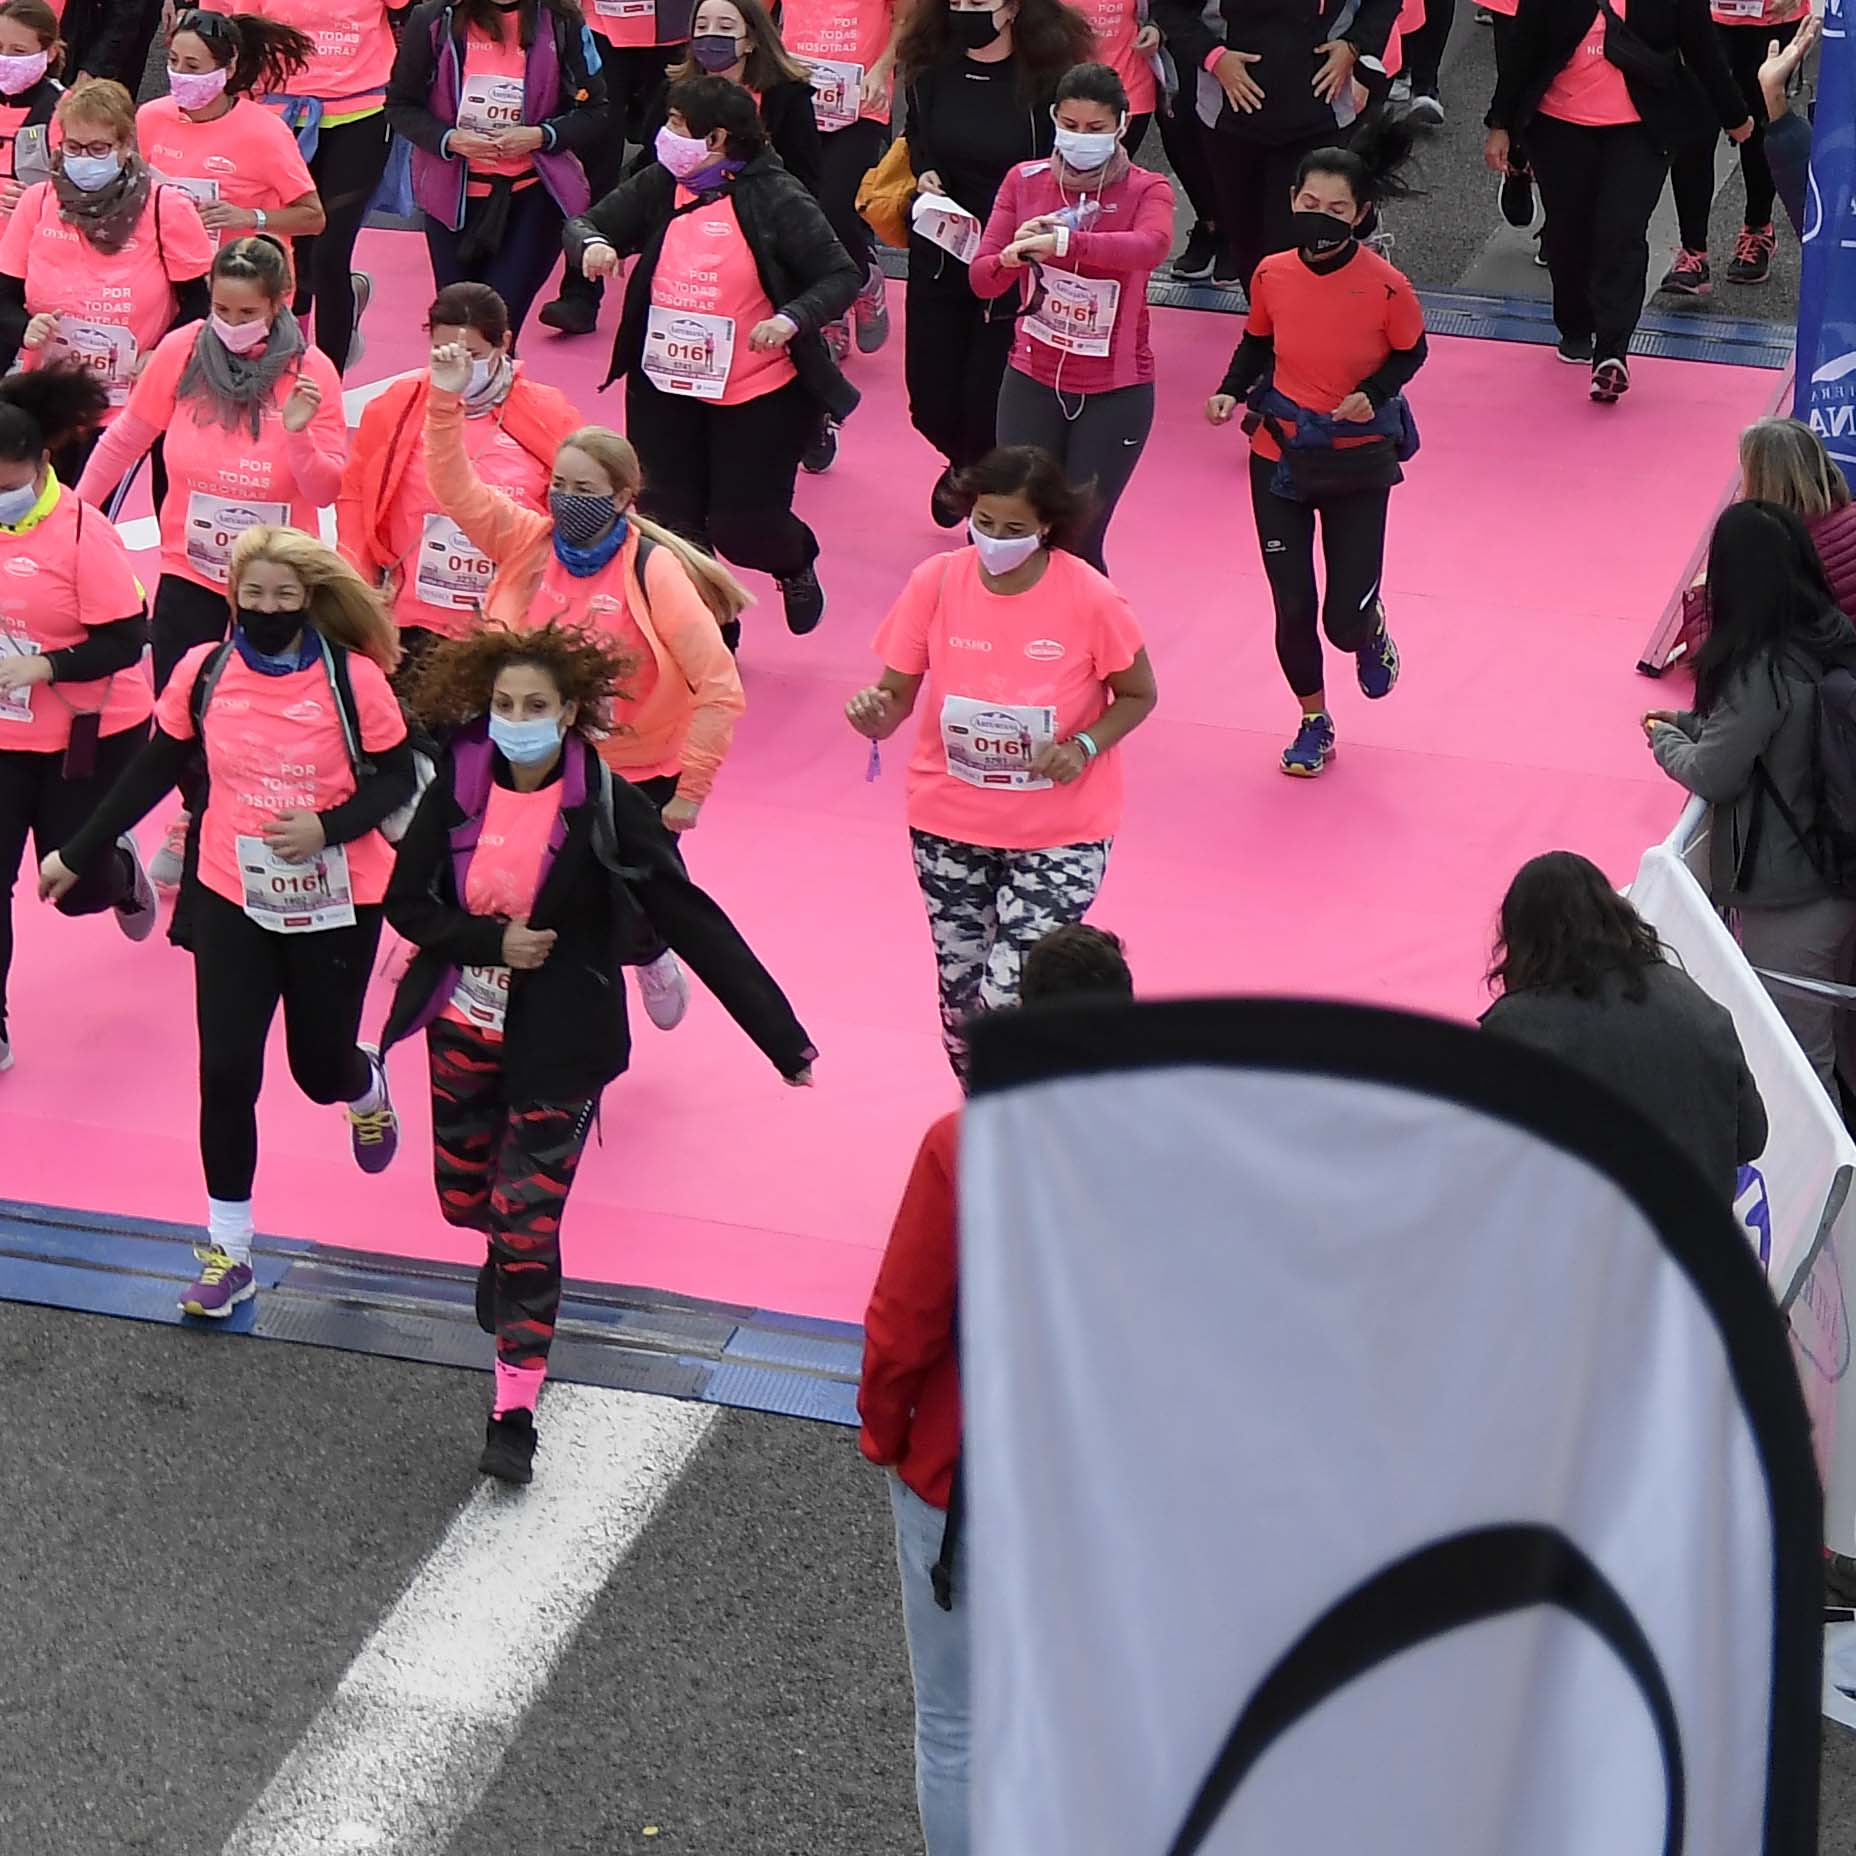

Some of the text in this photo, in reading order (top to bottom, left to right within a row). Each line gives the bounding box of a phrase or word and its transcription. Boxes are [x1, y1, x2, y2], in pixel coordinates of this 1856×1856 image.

[319, 31, 360, 44] TODAS
[815, 88, 838, 102] 16
[487, 106, 521, 121] 016
[689, 270, 719, 284] POR
[101, 287, 130, 299] POR
[85, 301, 131, 313] TODAS
[1052, 300, 1086, 318] 016
[668, 343, 703, 360] 016
[241, 459, 273, 474] POR
[217, 472, 272, 490] TODAS
[449, 556, 489, 574] 016
[975, 738, 1019, 754] 016
[280, 763, 316, 778] POR
[270, 875, 316, 893] 016
